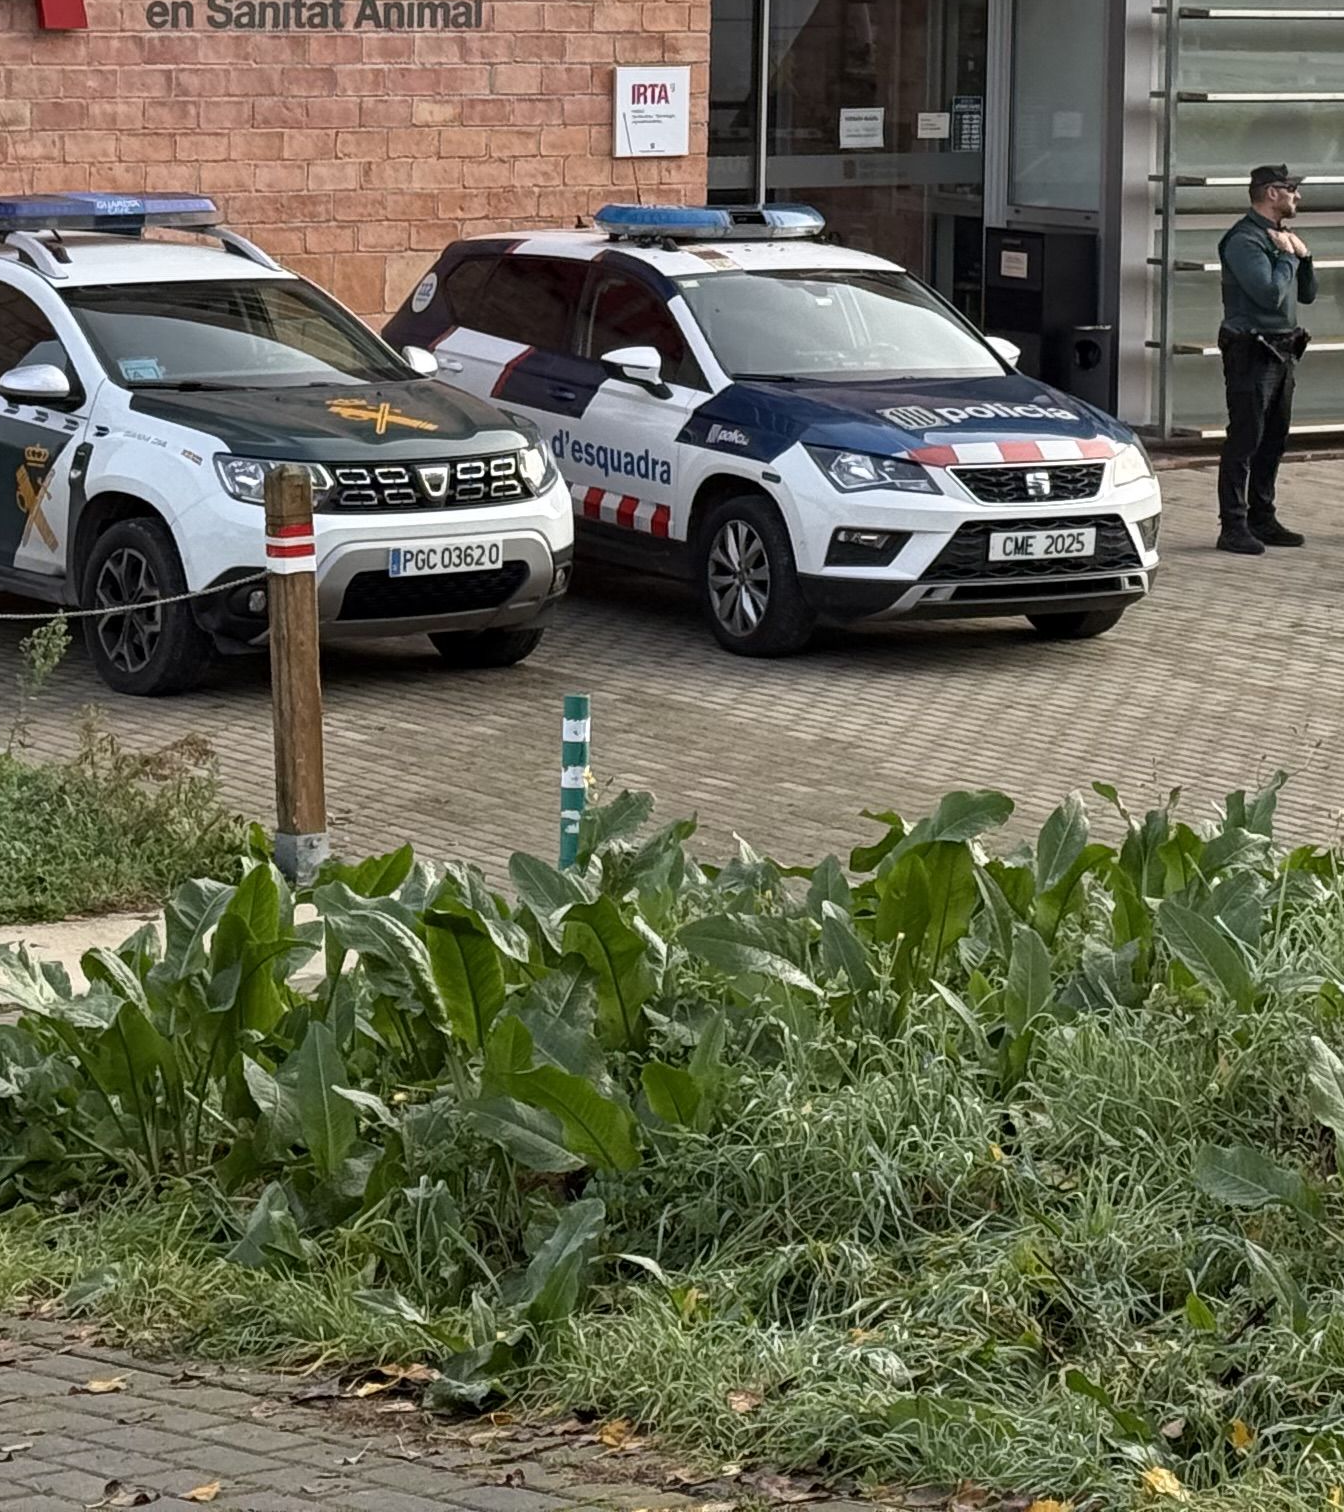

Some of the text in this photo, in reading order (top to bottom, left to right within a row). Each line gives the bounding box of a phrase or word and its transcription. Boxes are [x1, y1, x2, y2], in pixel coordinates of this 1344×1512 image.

[146, 0, 194, 29] en
[631, 83, 670, 105] IRTA
[934, 403, 1080, 423] policia
[552, 429, 672, 485] d'esquadra
[1002, 532, 1085, 556] CME 2025
